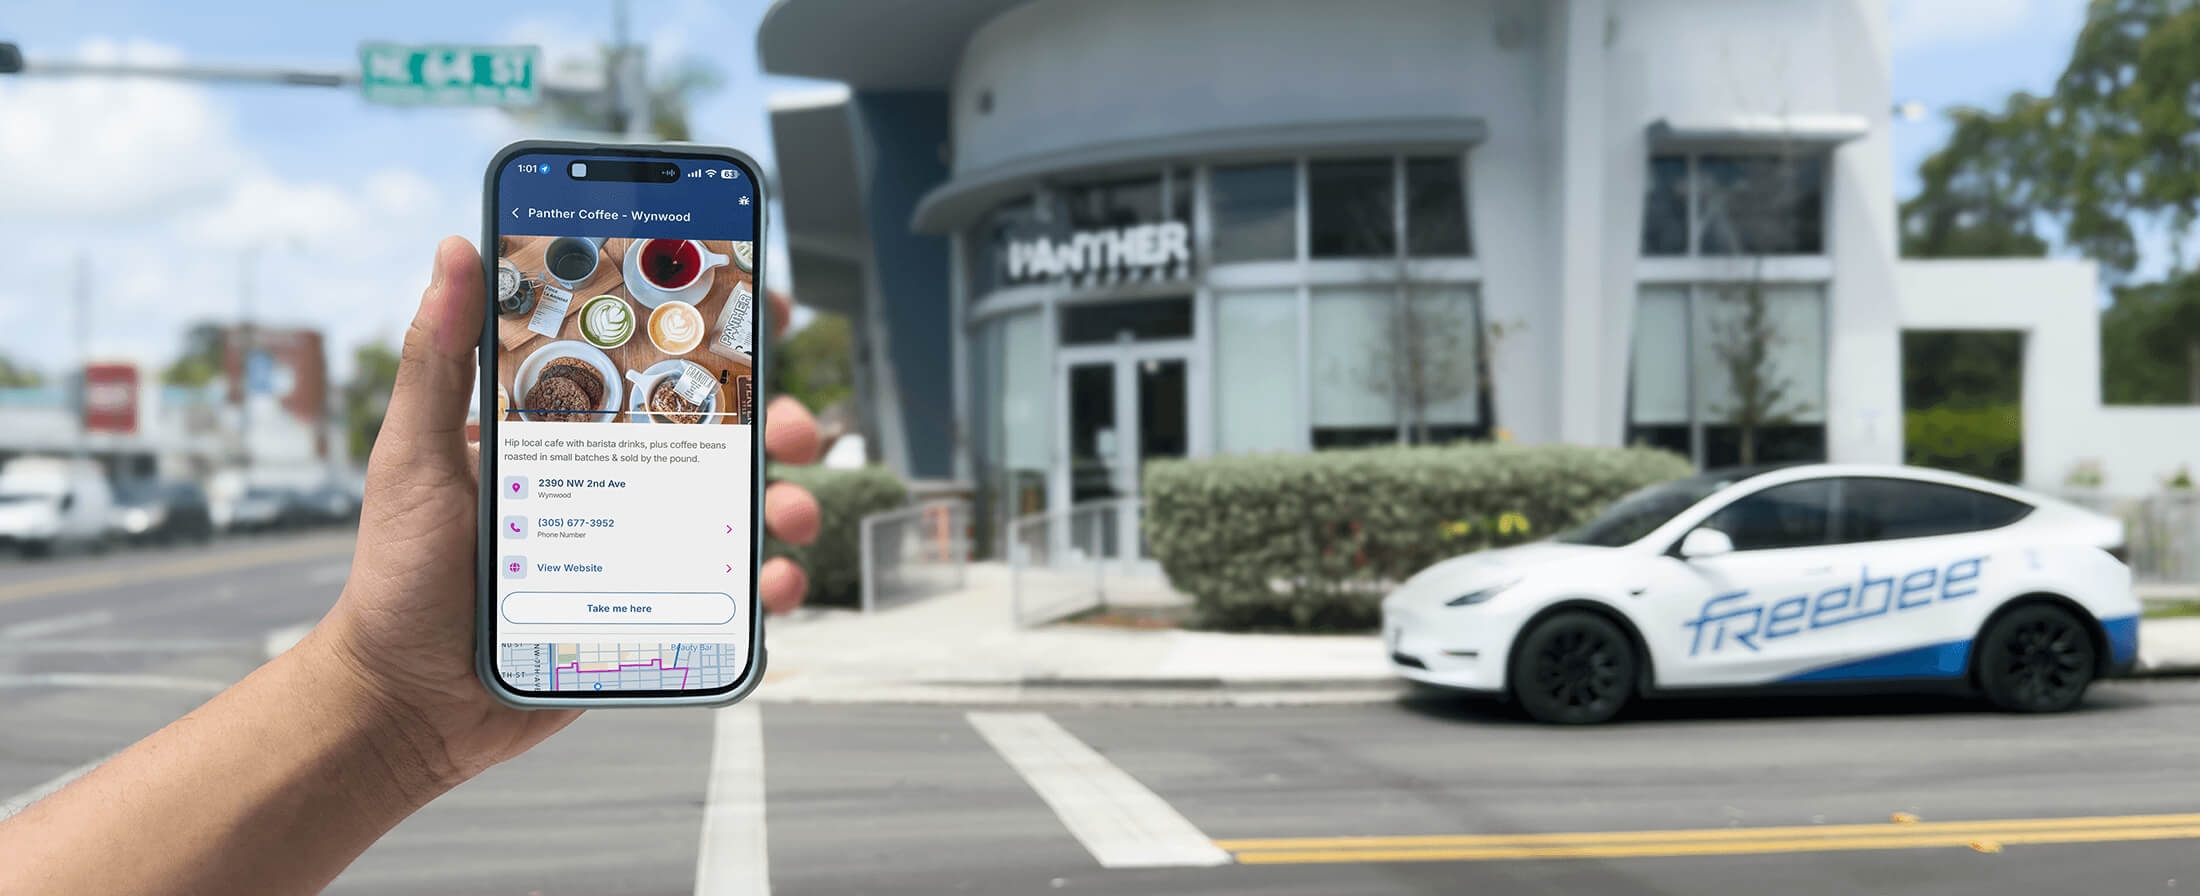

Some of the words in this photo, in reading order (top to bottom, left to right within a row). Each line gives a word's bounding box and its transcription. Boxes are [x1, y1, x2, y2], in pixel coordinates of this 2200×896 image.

[518, 164, 537, 174] 1:01
[724, 170, 736, 178] 63
[528, 207, 576, 219] Panther
[578, 208, 619, 221] Coffee
[631, 210, 691, 224] Wynwood
[1009, 221, 1189, 279] PANTHER
[720, 293, 751, 347] PANTHER
[504, 438, 520, 449] Hip
[521, 438, 543, 448] local
[544, 438, 564, 448] cafe
[566, 438, 585, 448] with
[586, 439, 617, 449] barista
[618, 439, 648, 450] drinks,
[649, 440, 668, 451] plus
[669, 440, 698, 450] coffee
[699, 440, 727, 450] beans
[504, 452, 538, 461] roasted
[539, 452, 548, 461] in
[550, 452, 573, 462] small
[574, 453, 610, 462] batches
[611, 453, 618, 462] &
[620, 453, 639, 463] sold
[640, 454, 652, 464] by
[653, 454, 668, 463] the
[669, 454, 700, 465] pound.
[538, 478, 564, 488] 2390
[566, 479, 584, 488] NW
[587, 479, 606, 488] 2nd
[607, 479, 626, 488] Ave
[537, 491, 572, 500] Wynwood
[538, 517, 564, 528] (305)
[566, 518, 615, 528] 677-3952
[537, 530, 558, 539] Phone
[559, 531, 586, 539] Number
[537, 563, 561, 573] View
[563, 563, 603, 573] Website
[587, 604, 611, 613] Take
[613, 605, 628, 613] me
[629, 604, 652, 613] here
[1684, 556, 1984, 656] freebee
